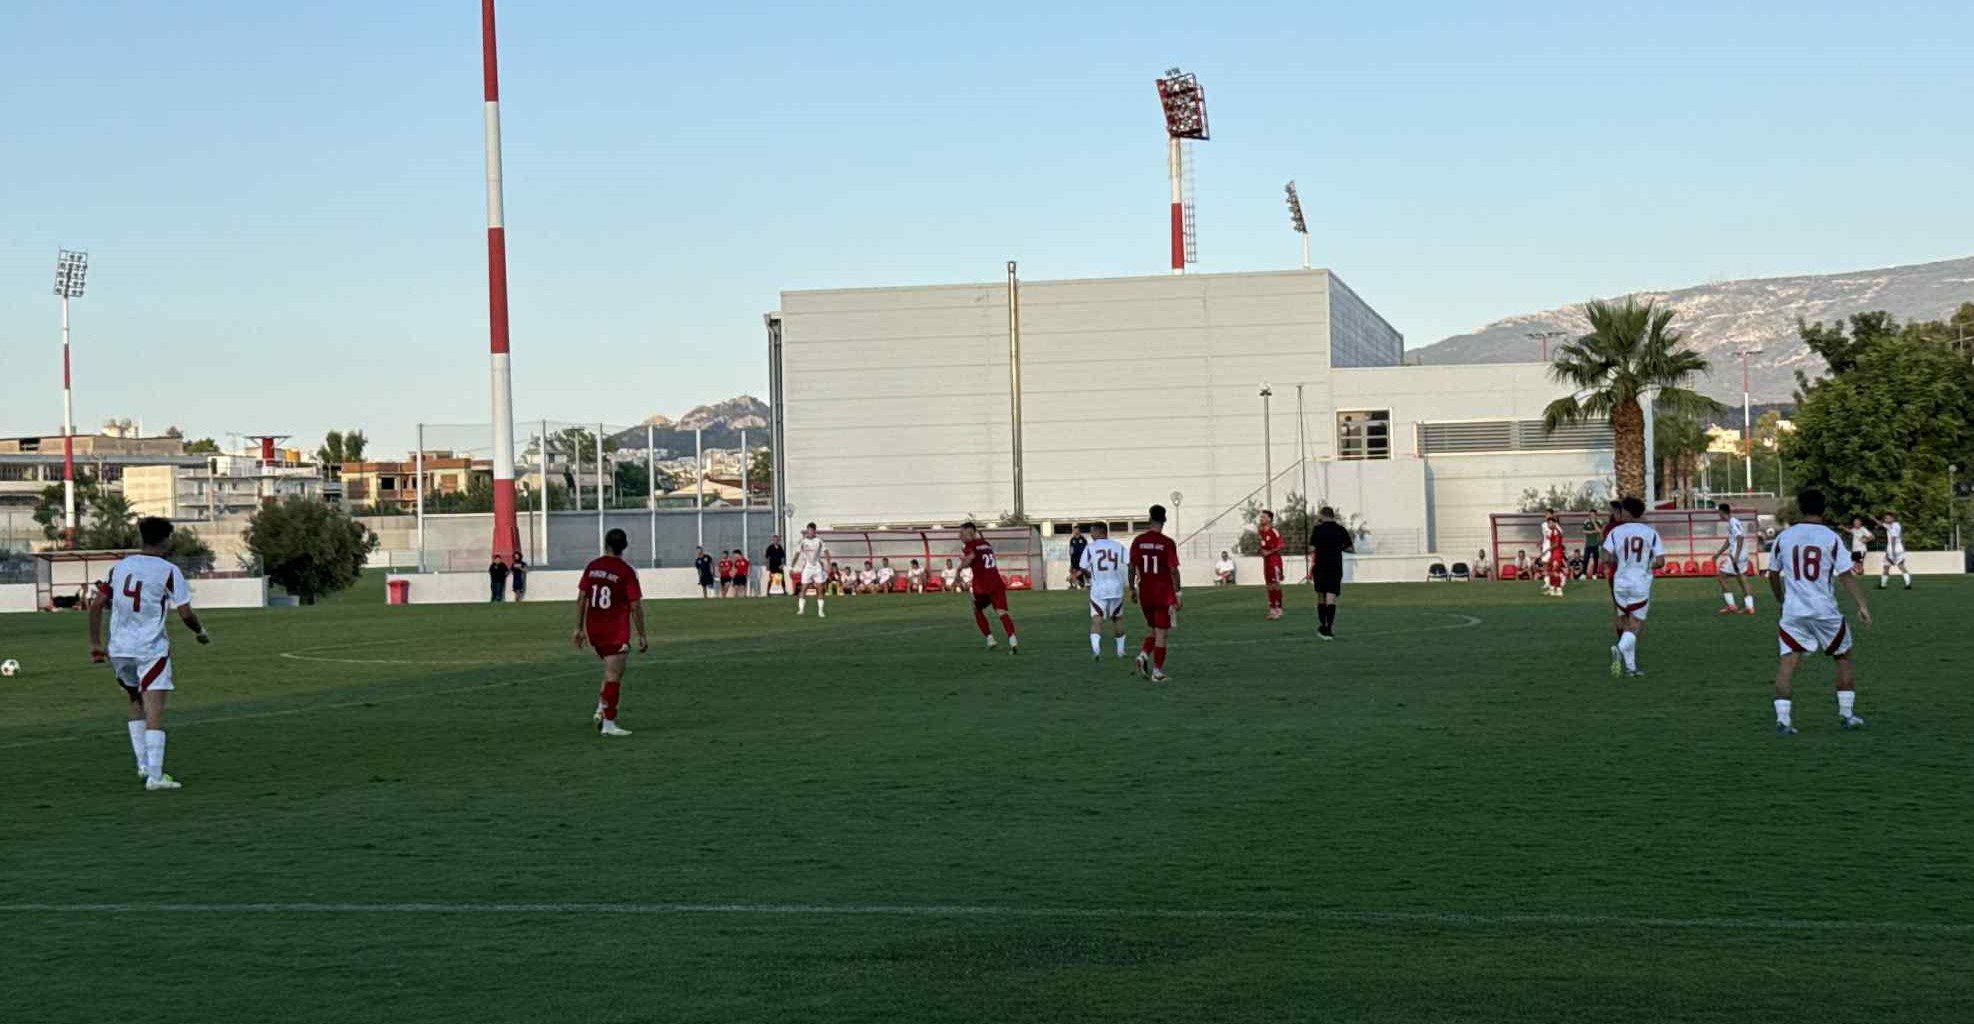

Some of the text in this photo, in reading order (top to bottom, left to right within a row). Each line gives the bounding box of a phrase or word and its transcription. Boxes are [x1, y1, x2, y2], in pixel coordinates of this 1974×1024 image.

[1095, 549, 1118, 572] 24
[1624, 536, 1644, 563] 19
[1142, 555, 1158, 574] 11
[1792, 545, 1822, 582] 18
[123, 573, 143, 613] 4
[591, 584, 611, 609] 18
